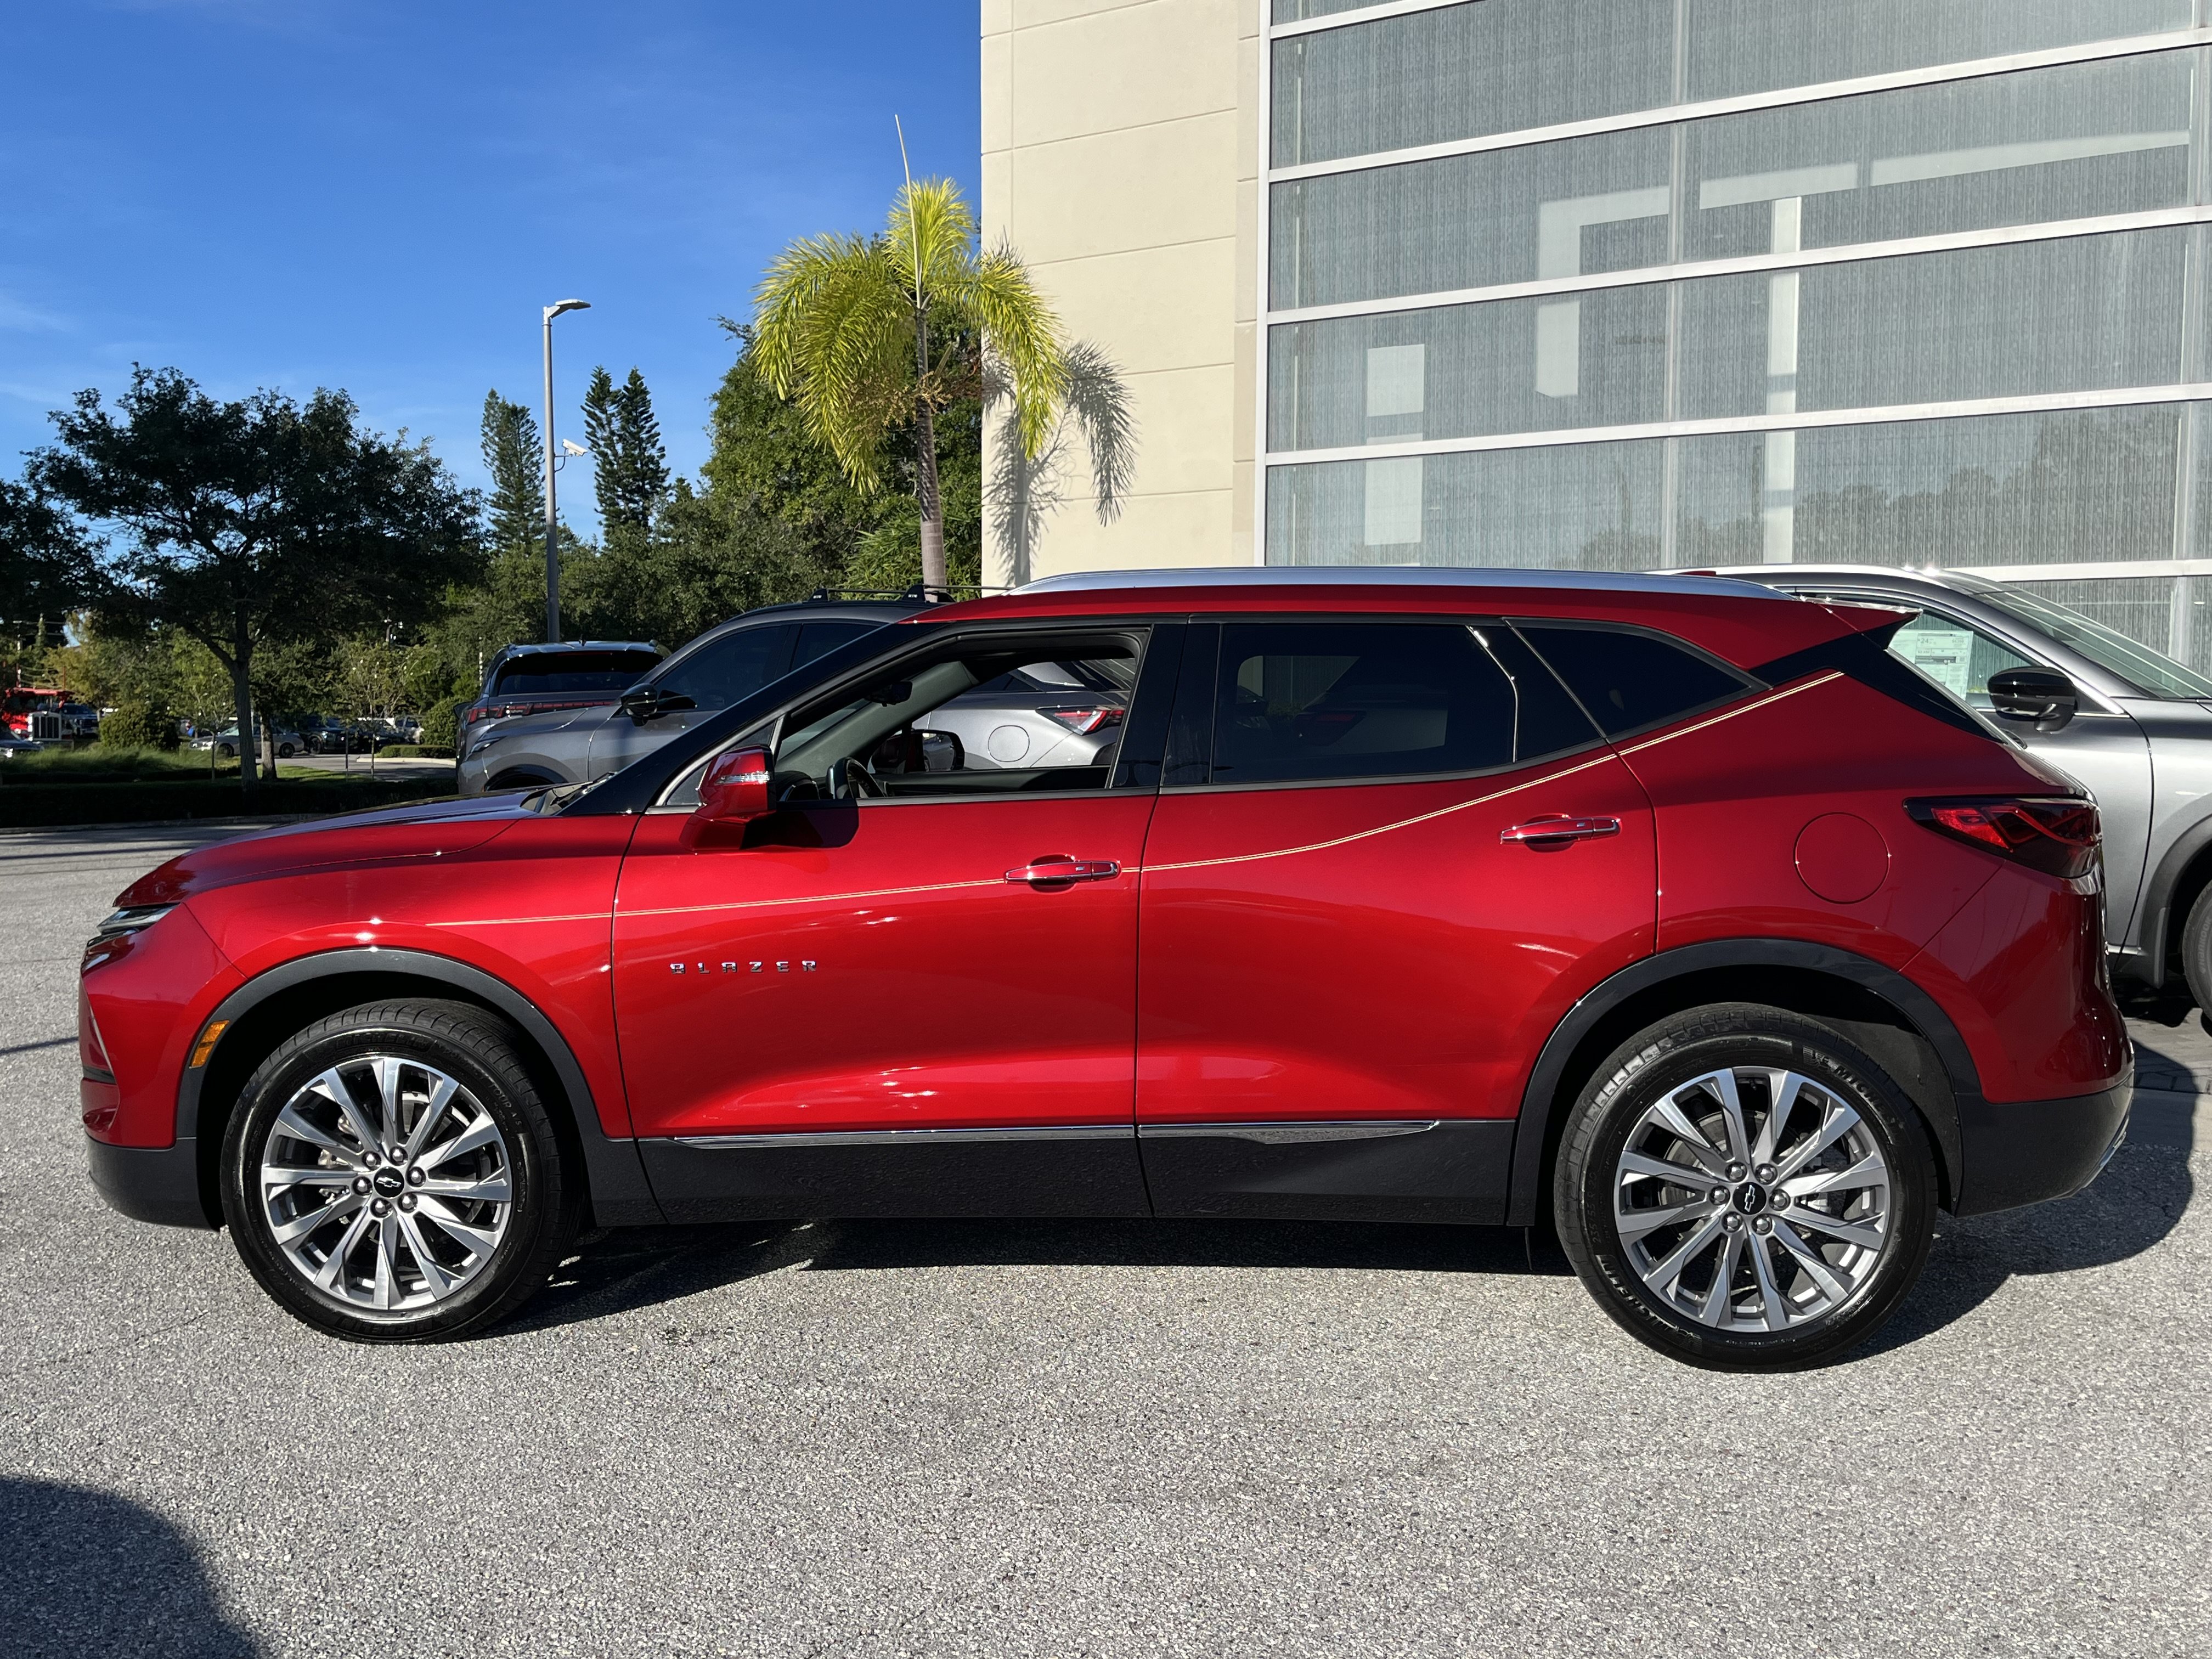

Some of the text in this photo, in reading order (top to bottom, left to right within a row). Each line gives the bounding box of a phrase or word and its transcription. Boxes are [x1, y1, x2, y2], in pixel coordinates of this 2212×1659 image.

[669, 960, 817, 974] BLAZER
[488, 1082, 512, 1109] TOUR
[510, 1110, 522, 1126] A/S
[1600, 1259, 1672, 1333] MICHELIN
